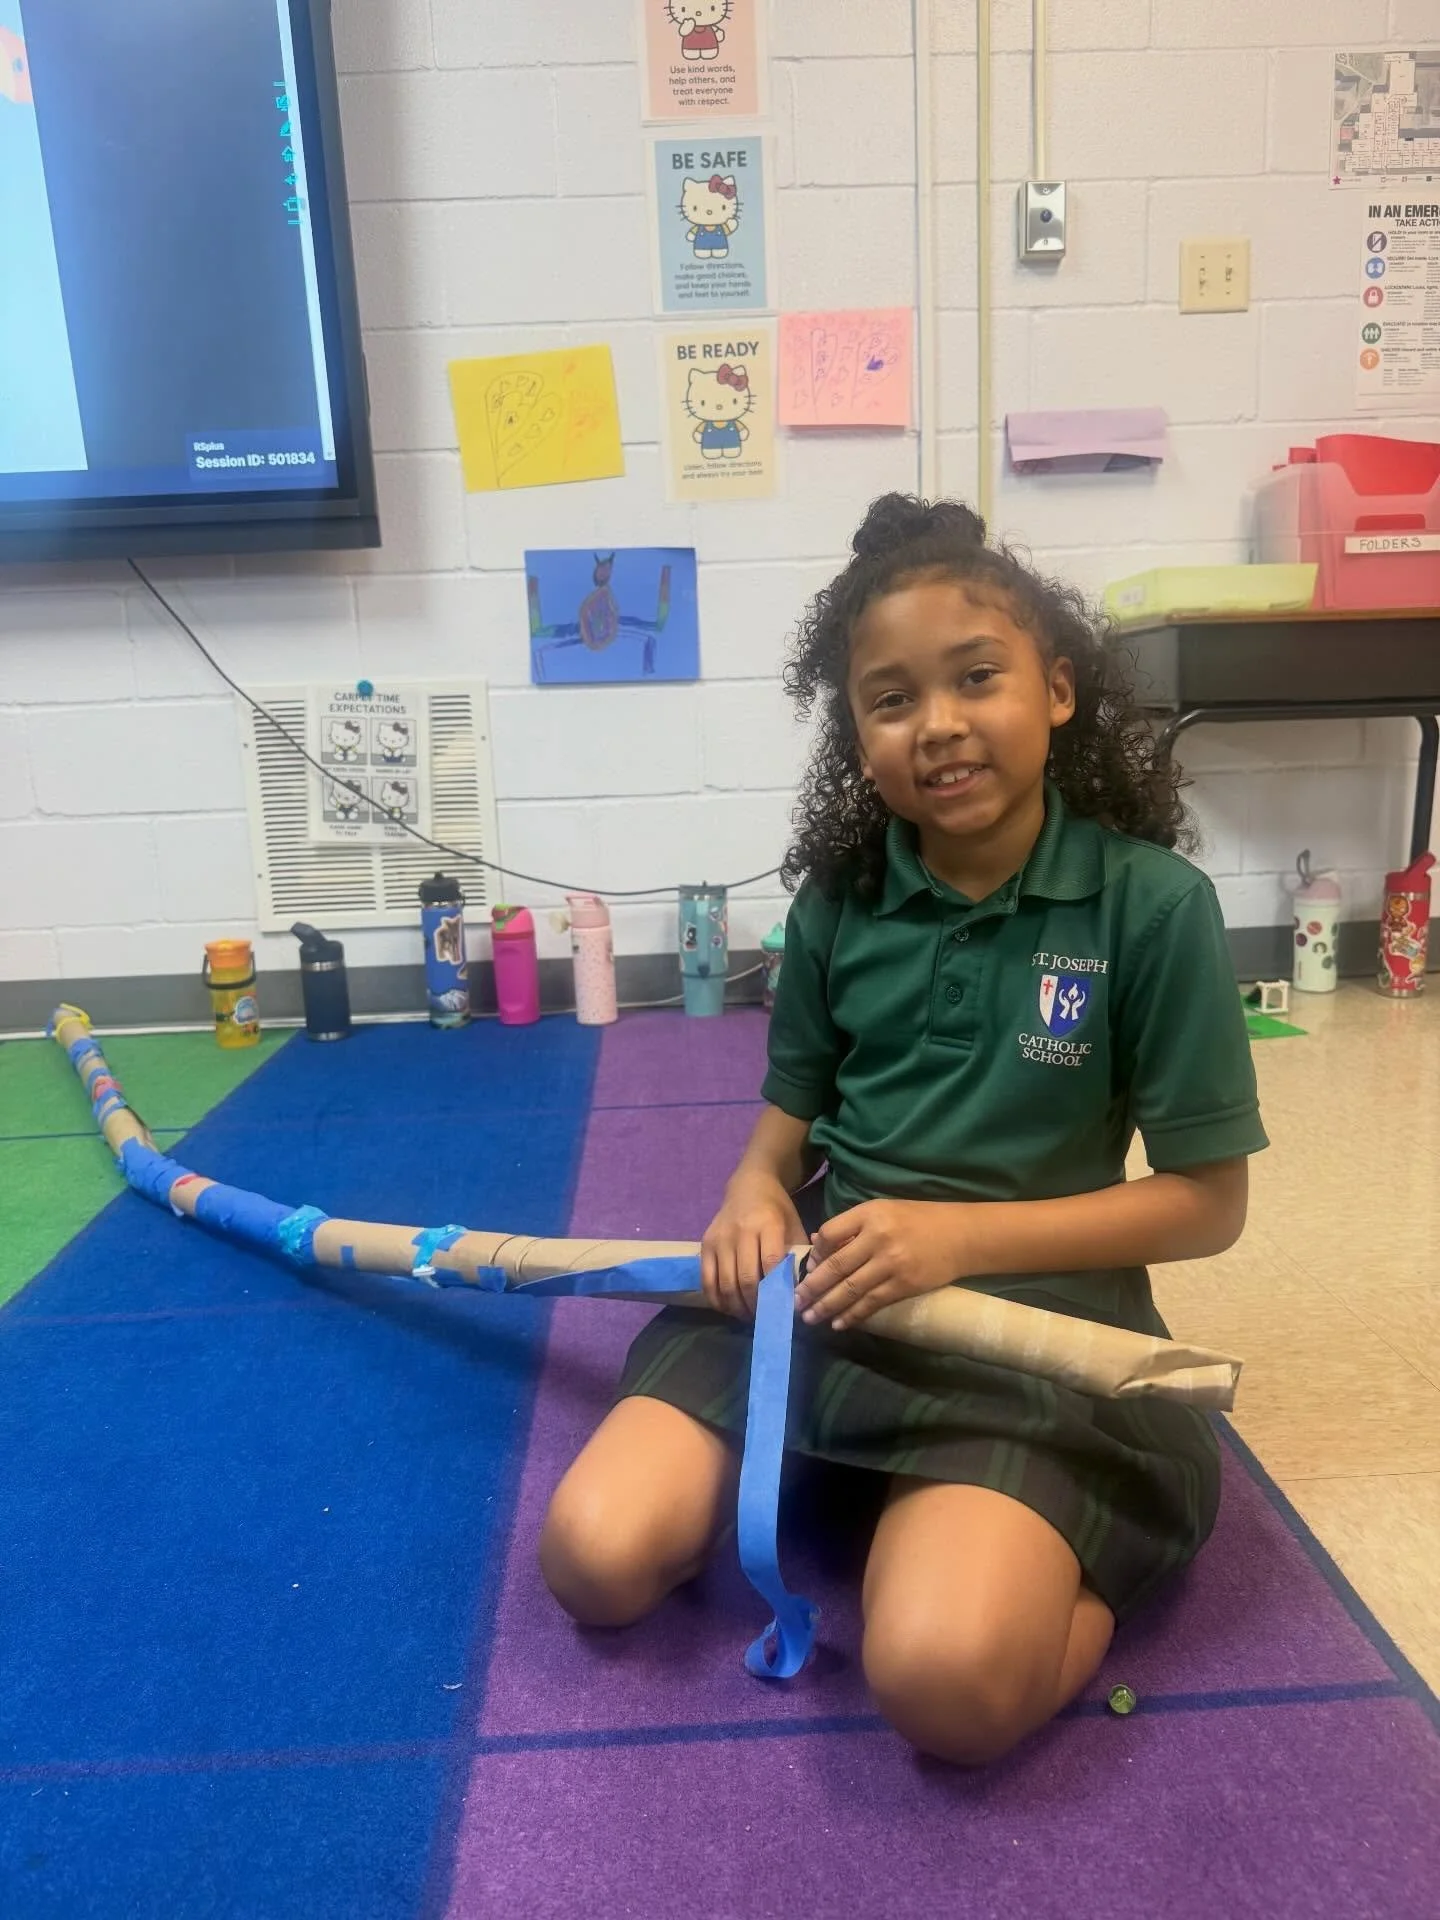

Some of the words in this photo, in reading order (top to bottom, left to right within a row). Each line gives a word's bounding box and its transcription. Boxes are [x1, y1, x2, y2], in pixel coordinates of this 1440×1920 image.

[670, 66, 686, 74] Use
[687, 65, 704, 73] kind
[706, 64, 736, 72] words,
[669, 77, 686, 85] help
[720, 76, 736, 84] and
[696, 88, 734, 96] everyone
[672, 152, 694, 170] BE
[700, 150, 748, 168] SAFE
[1368, 205, 1381, 218] IN
[1384, 204, 1402, 218] AN
[1404, 204, 1440, 218] EMER
[1395, 218, 1418, 226] TAKE
[1419, 218, 1440, 226] ACTI
[676, 344, 696, 360] BE
[702, 341, 760, 358] READY
[196, 454, 246, 468] Session
[246, 454, 266, 466] ID:
[268, 452, 316, 466] 501834
[1360, 537, 1422, 551] FOLDERS
[376, 692, 400, 704] TIME
[328, 704, 407, 714] EXPECTATIONS
[1050, 955, 1109, 974] JOSEPH
[1018, 1033, 1092, 1054] CATHOLIC
[1022, 1047, 1082, 1066] SCHOOL
